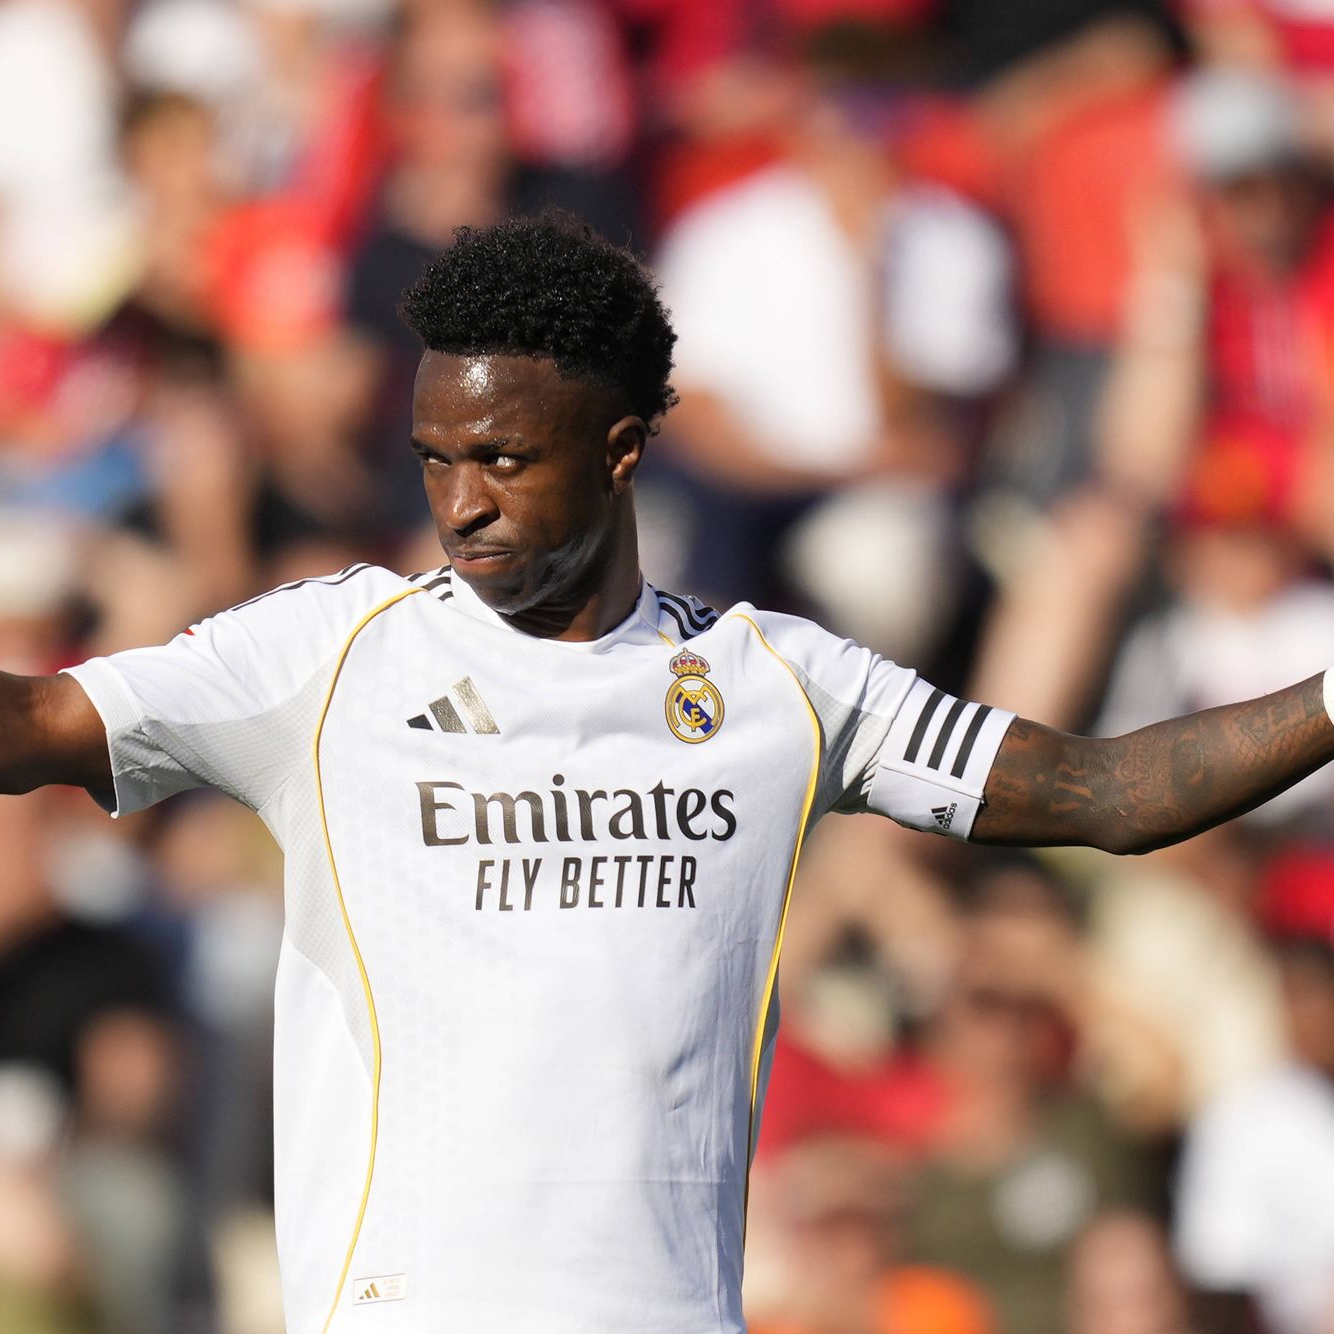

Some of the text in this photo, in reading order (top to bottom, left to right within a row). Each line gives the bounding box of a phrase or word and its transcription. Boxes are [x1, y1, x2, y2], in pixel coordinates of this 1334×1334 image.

[415, 774, 737, 846] Emirates
[943, 802, 958, 830] adidas
[475, 855, 697, 911] FLY BETTER
